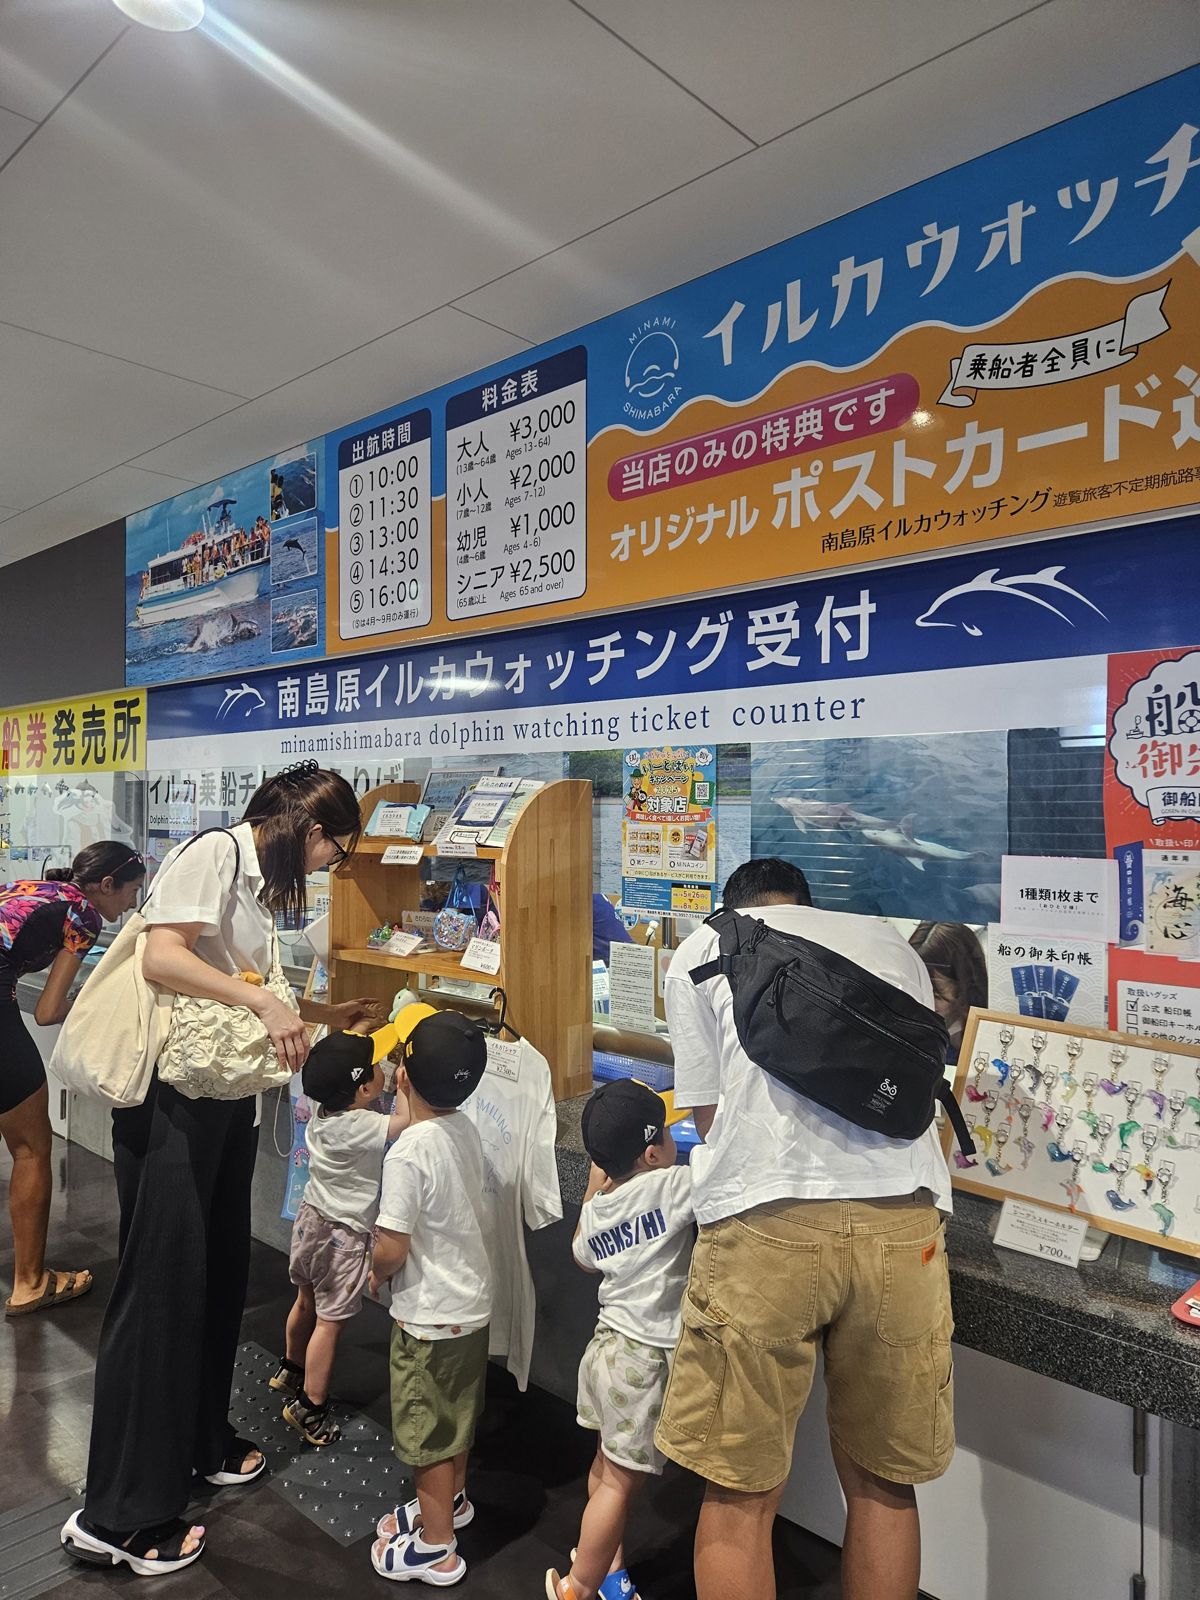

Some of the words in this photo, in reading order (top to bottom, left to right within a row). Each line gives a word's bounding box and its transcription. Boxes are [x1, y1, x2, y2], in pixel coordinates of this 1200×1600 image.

[628, 316, 677, 346] MINAMI
[965, 335, 1117, 382] 乗船者全員に
[481, 369, 539, 412] 料金表
[622, 383, 684, 421] SHIMABARA
[351, 421, 412, 464] 出航時間
[457, 431, 489, 462] 大人
[509, 399, 576, 442] ¥3,000
[620, 386, 897, 495] 当店のみの特典です
[505, 446, 523, 460] Ages
[369, 455, 419, 491] 10:00
[456, 478, 489, 507] 小人
[509, 450, 576, 490] ¥2,000
[369, 486, 419, 521] 11:30
[504, 494, 522, 507] Ages
[369, 517, 419, 550] 13:00
[456, 526, 487, 552] 幼児
[510, 501, 576, 538] ¥1,000
[609, 498, 761, 563] オリジナル
[820, 487, 1052, 554] 南島原イルカウォッチング
[369, 547, 419, 580] 14:30
[503, 541, 521, 555] Ages
[456, 565, 505, 595] シニア
[510, 548, 576, 583] ¥2,500
[369, 578, 419, 609] 16:00
[500, 590, 517, 602] Ages
[545, 577, 565, 591] over)
[277, 589, 878, 719] 南島原イルカウォッチング受付
[280, 727, 422, 754] minamishimabara
[428, 719, 505, 750] dolphin
[512, 706, 621, 744] watching
[629, 702, 710, 731] ticket
[733, 694, 867, 727] counter
[647, 796, 687, 813] 対象店
[1161, 791, 1200, 807] 御船
[149, 815, 169, 826] Dolphin
[1019, 887, 1099, 904] 1種類1枚まで
[997, 943, 1094, 966] 船の御朱印帳
[1142, 1003, 1160, 1014] 公式
[1039, 1243, 1064, 1258] ¥700
